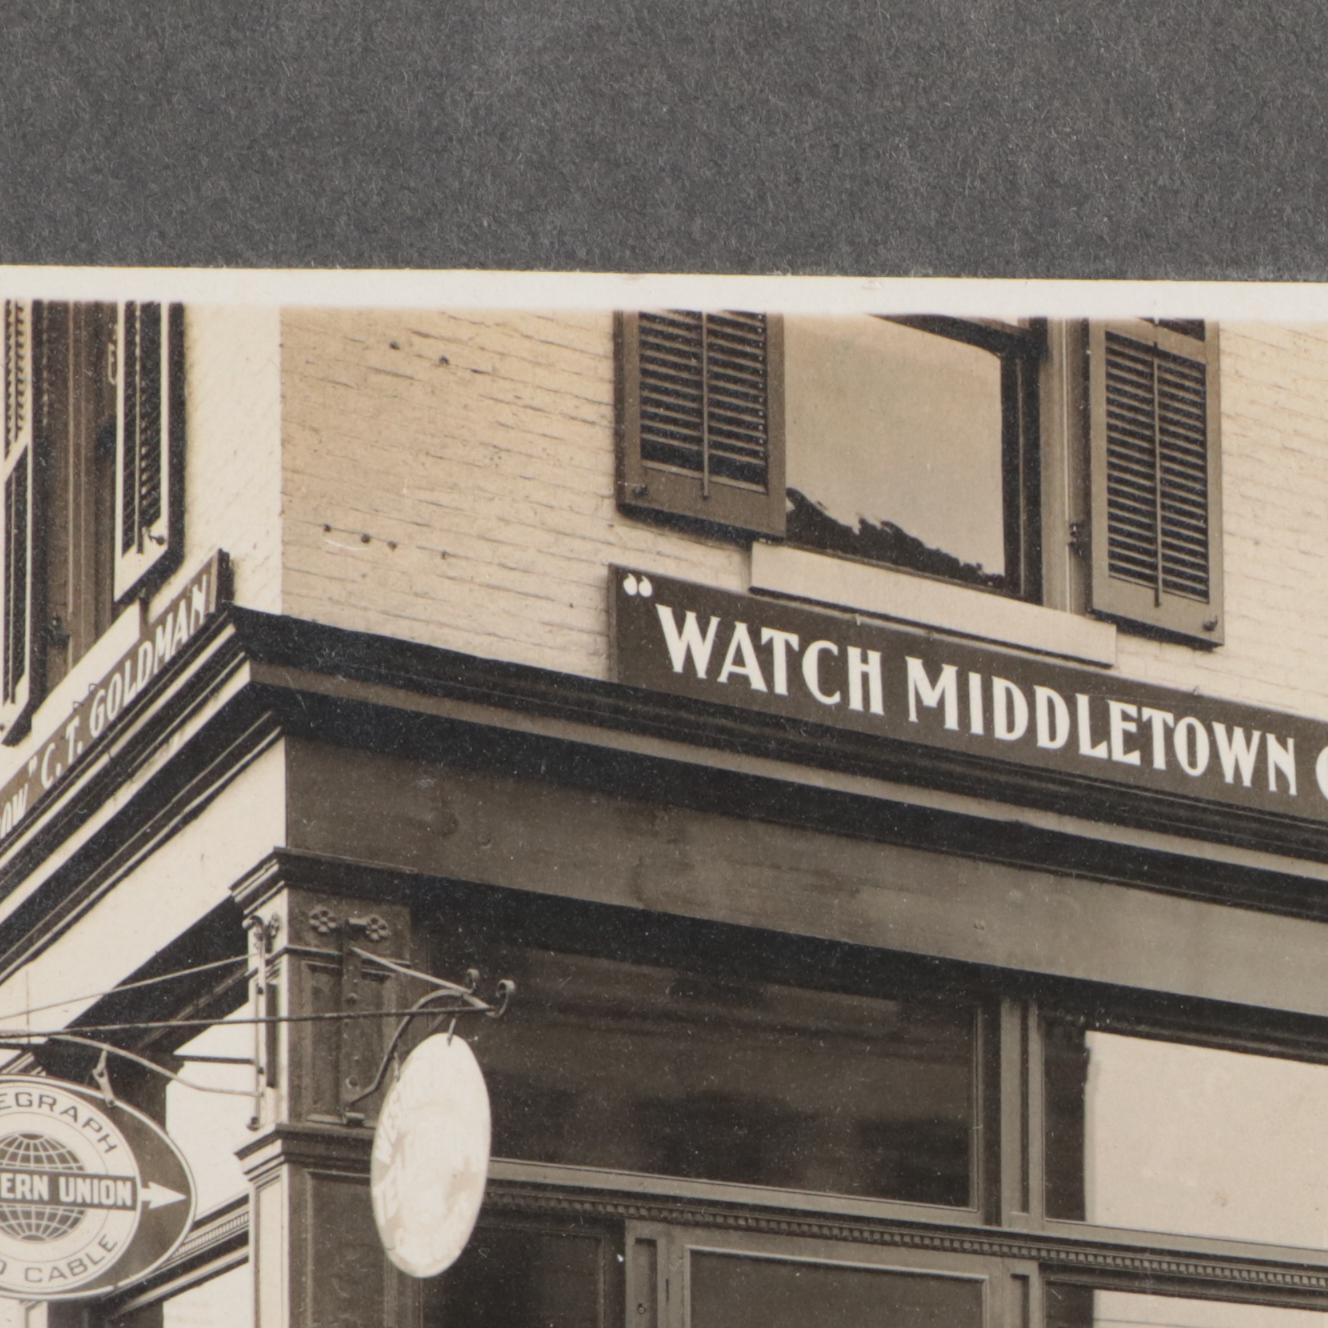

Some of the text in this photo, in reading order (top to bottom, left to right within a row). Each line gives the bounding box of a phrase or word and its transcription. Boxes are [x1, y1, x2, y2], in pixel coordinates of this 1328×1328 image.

[89, 573, 208, 738] GOLDMAN
[905, 656, 1298, 797] MIDDLETOWN
[59, 1175, 133, 1207] UNION
[24, 1233, 118, 1284] CABLE
